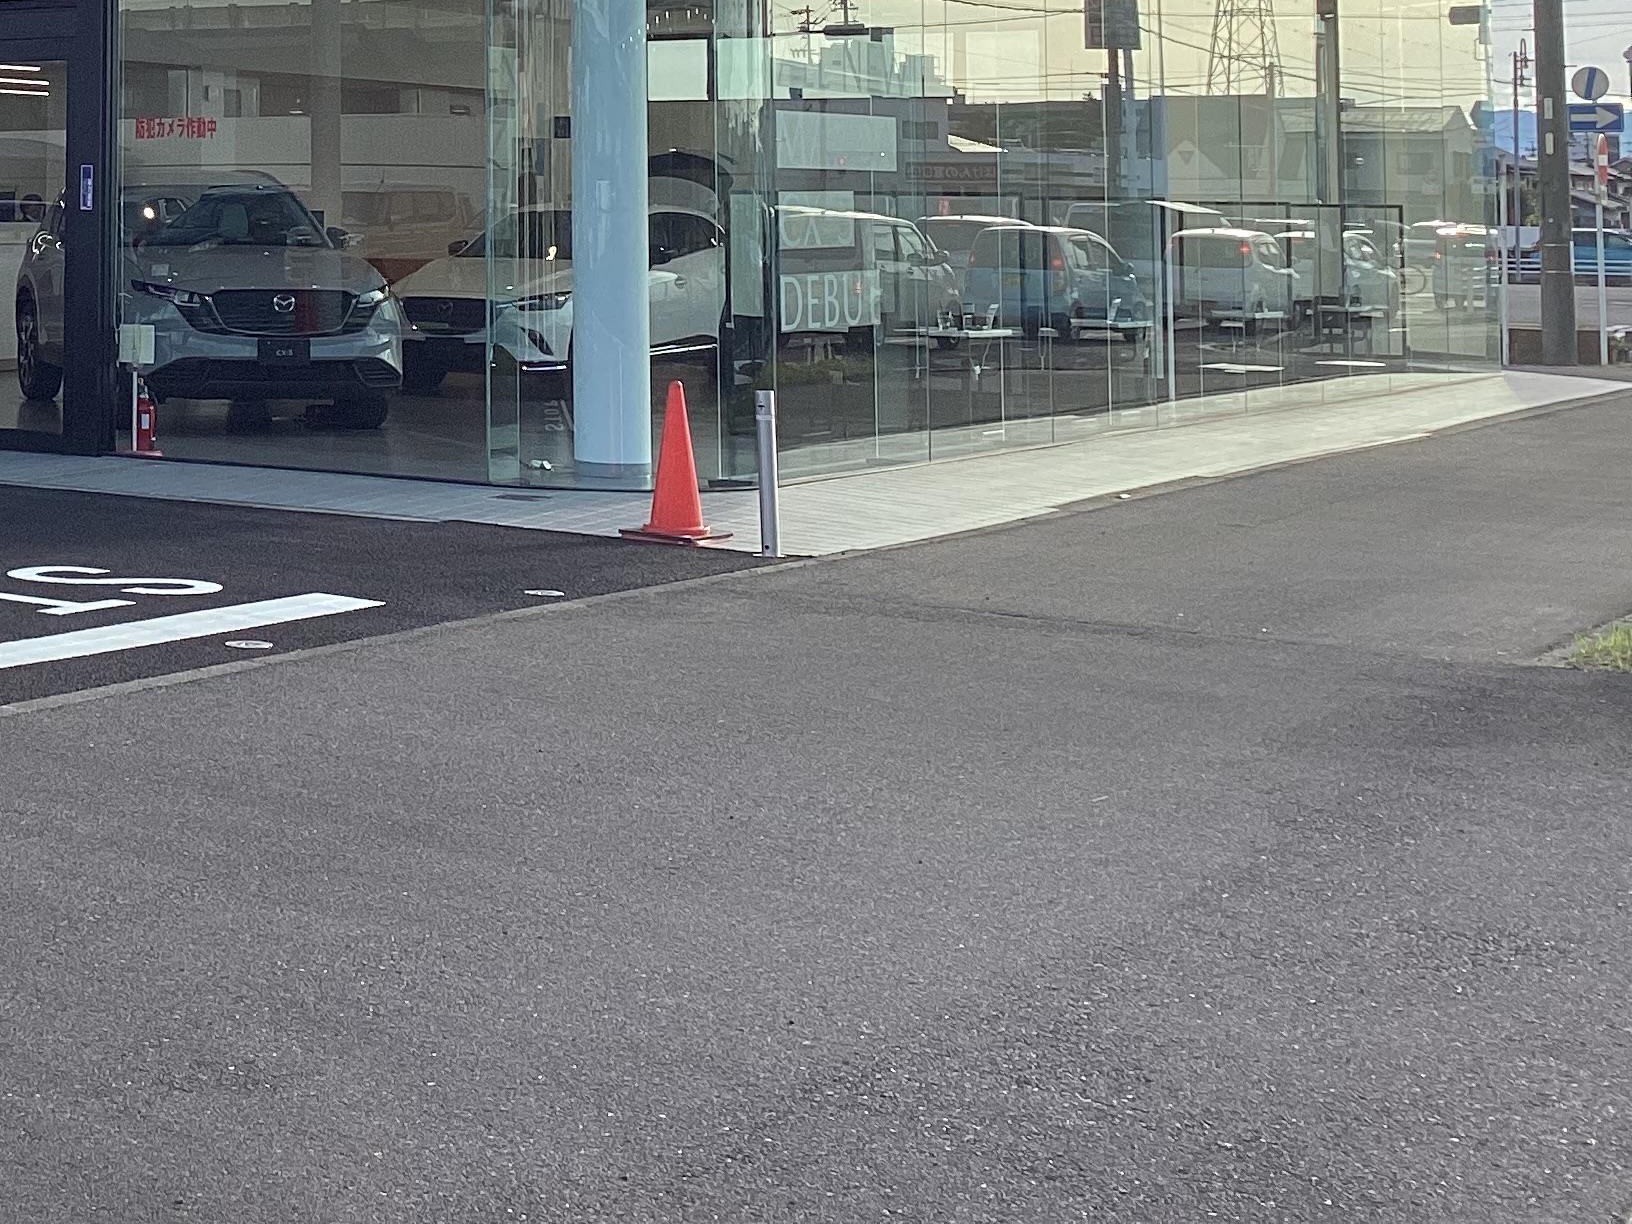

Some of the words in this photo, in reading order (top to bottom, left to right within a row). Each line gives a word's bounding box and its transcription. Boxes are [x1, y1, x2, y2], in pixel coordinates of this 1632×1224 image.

[135, 117, 217, 139] 防犯カメラ作動中
